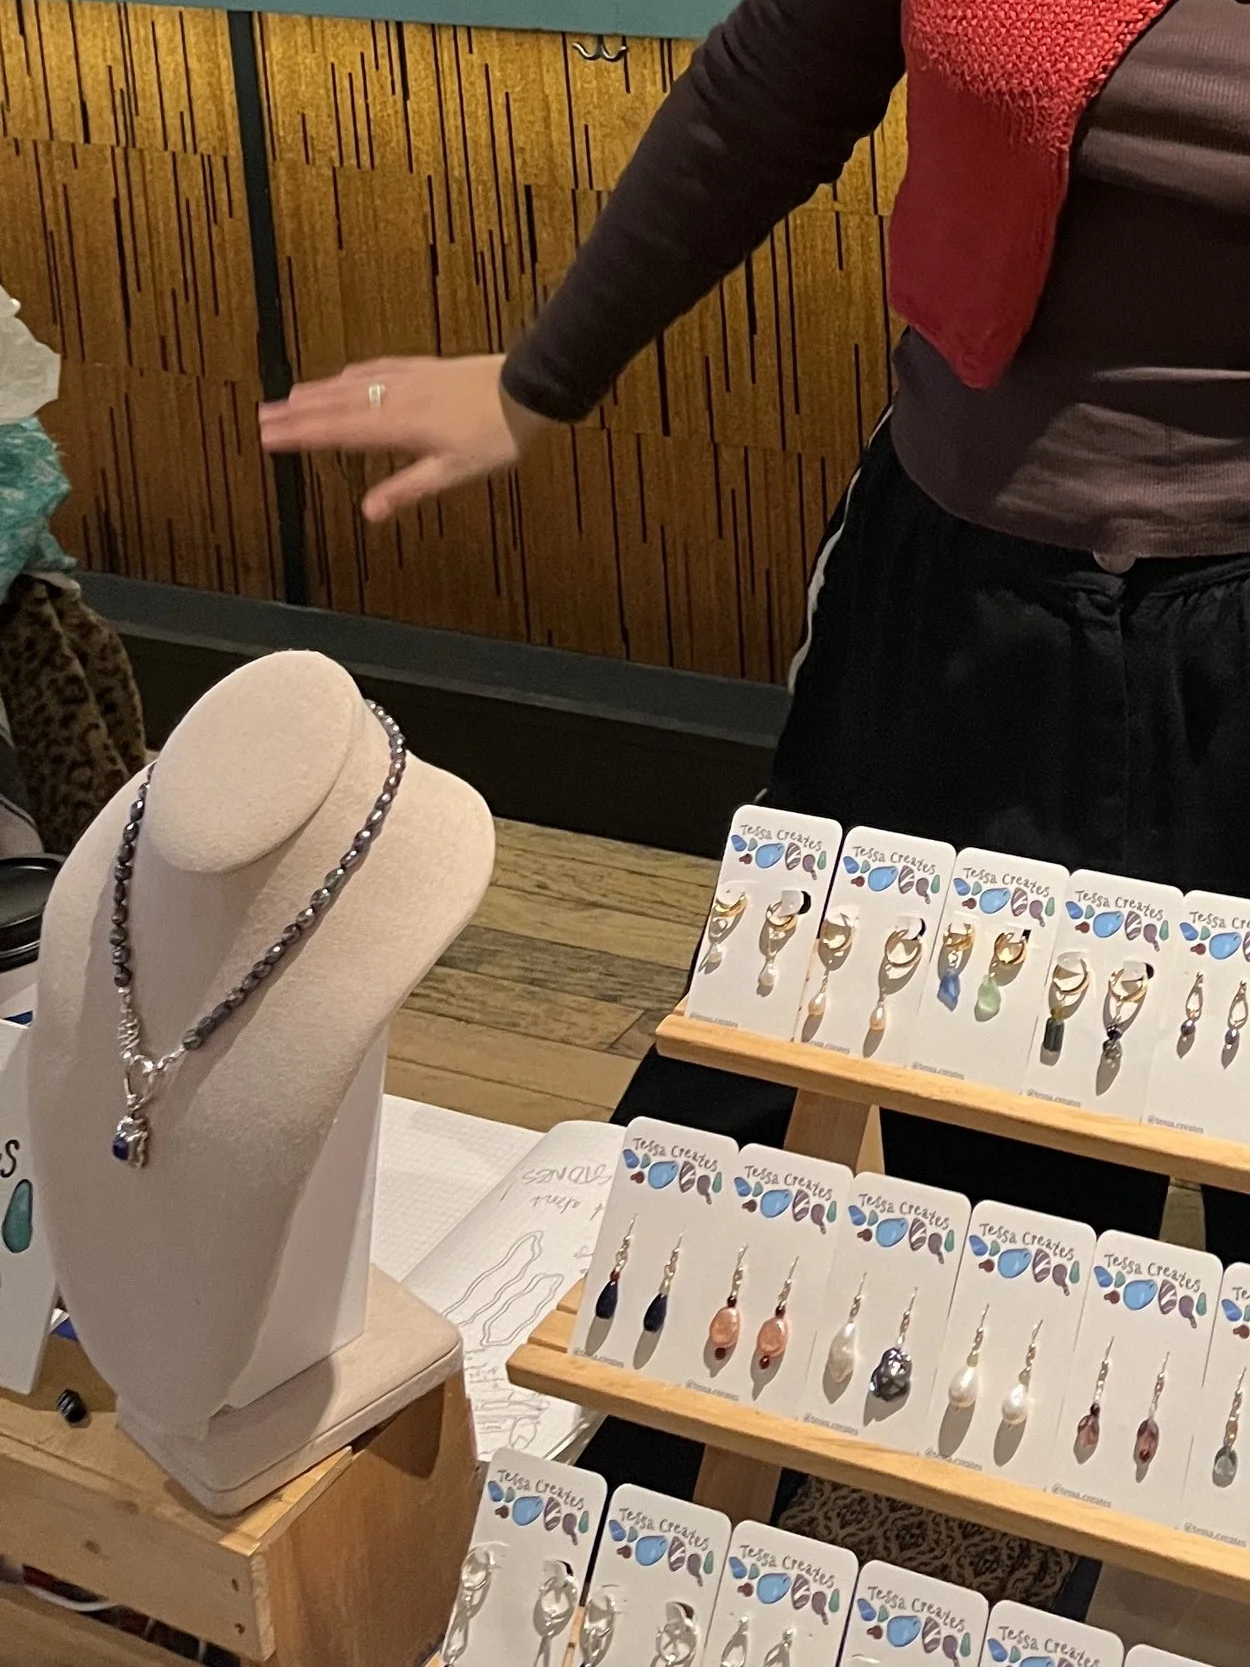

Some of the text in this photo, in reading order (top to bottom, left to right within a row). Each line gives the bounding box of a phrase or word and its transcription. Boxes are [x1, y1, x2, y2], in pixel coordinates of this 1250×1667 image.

[740, 824, 822, 851] Tessa Creates
[853, 845, 935, 875] Tessa Creates
[963, 867, 1051, 898] Tessa Creates
[1075, 890, 1164, 921] Tessa Creates
[1189, 911, 1226, 929] Tessa
[0, 1139, 20, 1178] S
[633, 1137, 718, 1172] Tessa Creates
[744, 1165, 833, 1201] Tessa Creates
[858, 1193, 949, 1230] Tessa Creates
[979, 1222, 1074, 1261] Tessa Creates
[1104, 1253, 1201, 1293] Tessa Creates
[497, 1469, 585, 1511] Tessa Creates
[619, 1508, 709, 1551] Tessa Creates
[740, 1544, 834, 1589] Tessa Creates
[867, 1585, 965, 1633] Tessa Creates
[998, 1626, 1039, 1651] Tessa
